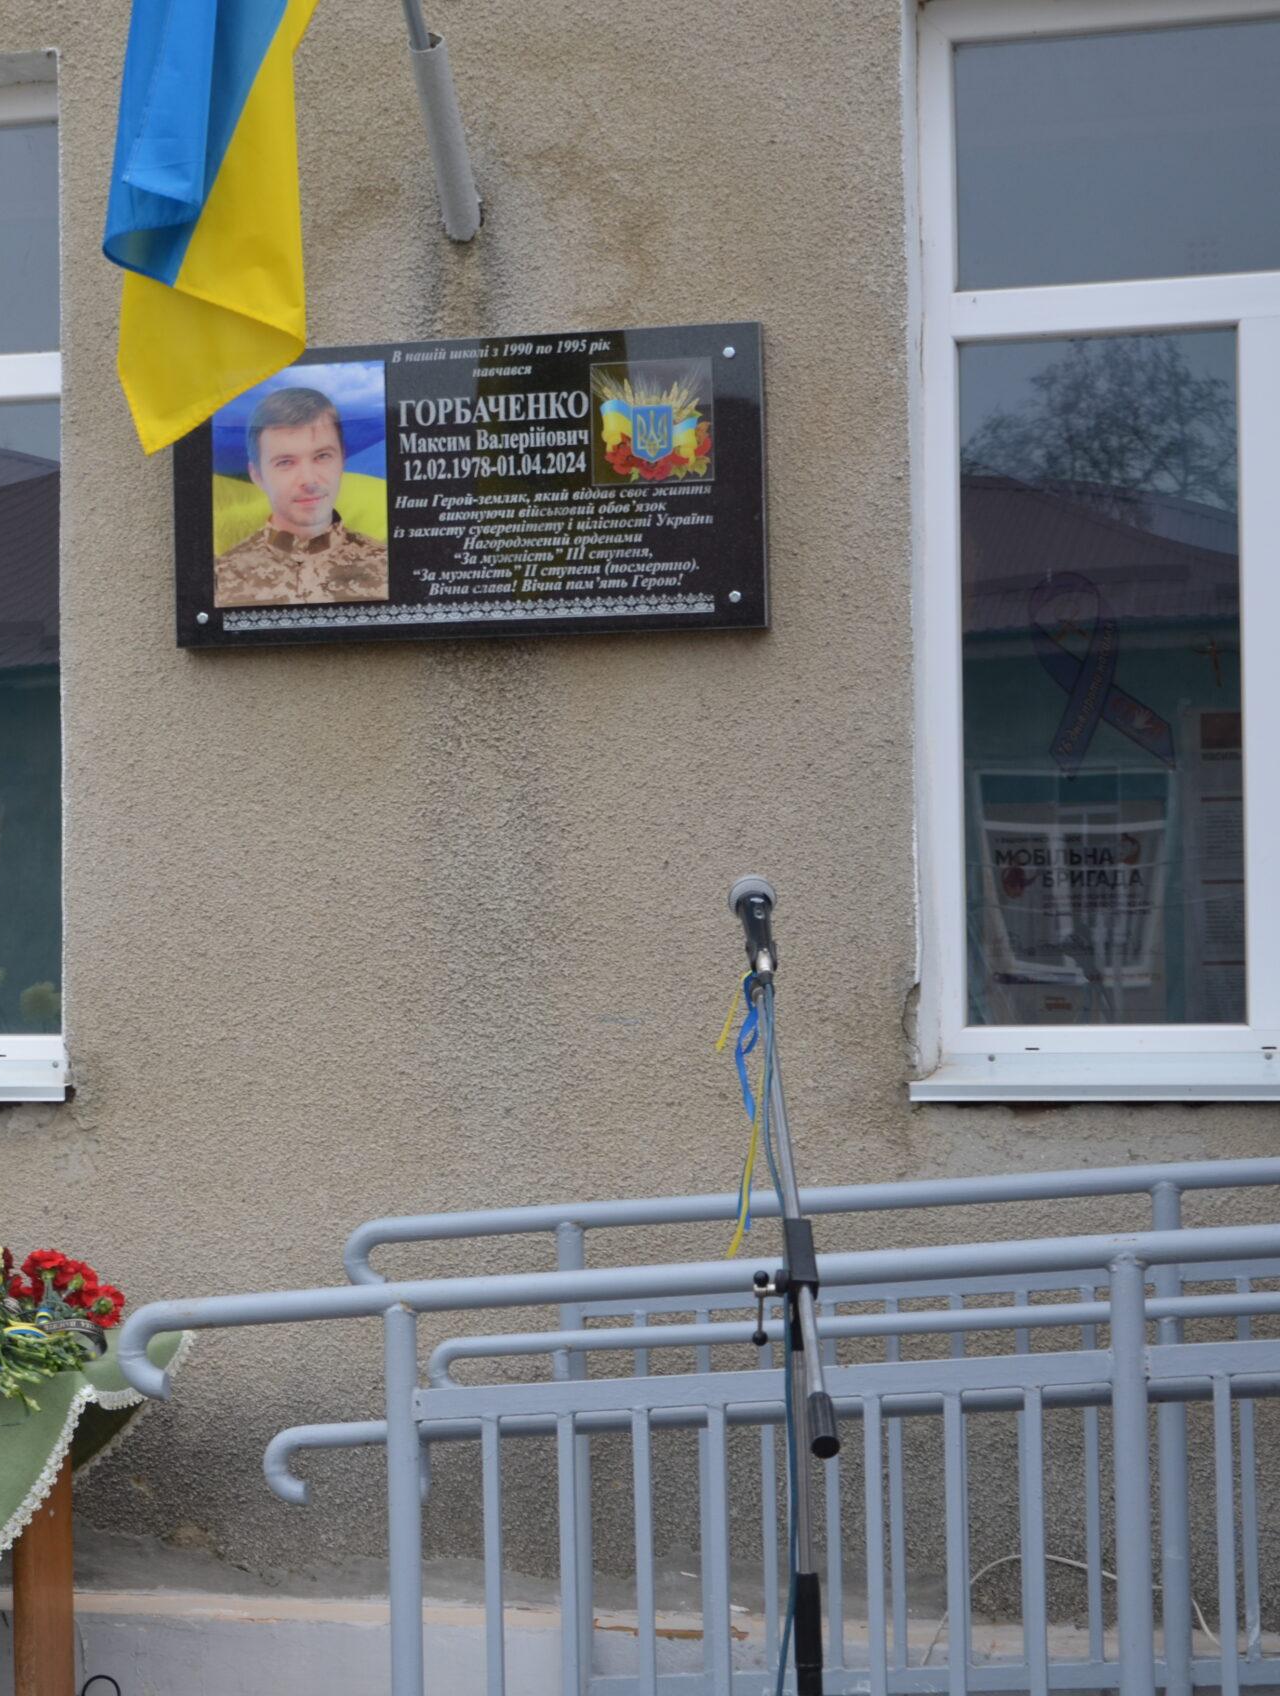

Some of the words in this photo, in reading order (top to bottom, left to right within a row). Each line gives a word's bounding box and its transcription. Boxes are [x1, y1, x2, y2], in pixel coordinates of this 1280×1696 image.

[392, 351, 401, 363] В
[405, 349, 446, 362] нашій
[449, 345, 489, 360] школі
[492, 348, 499, 358] з
[503, 342, 533, 357] 1990
[535, 344, 553, 356] по
[557, 340, 587, 354] 1995
[589, 339, 611, 355] рік
[472, 365, 532, 378] навчався
[398, 390, 589, 427] ГОРБАЧЕНКО
[400, 432, 470, 454] Максим
[476, 426, 589, 454] Валерійович
[404, 451, 586, 481] 12.02.1978-01.04.2024
[395, 496, 427, 509] Наш
[432, 493, 530, 509] Герой-земляк,
[534, 489, 569, 503] який
[572, 489, 616, 501] віддав
[652, 484, 712, 496] життя
[438, 507, 515, 522] виконуючи
[519, 503, 595, 517] військовий
[393, 526, 404, 538] із
[408, 524, 466, 538] захисту
[468, 520, 565, 537] суверенітету
[567, 520, 573, 531] і
[576, 515, 652, 533] цілісності
[656, 513, 714, 529] України
[463, 534, 571, 551] Нагороджений
[573, 532, 643, 547] орденами
[589, 548, 653, 562] ступеня,
[540, 564, 601, 578] ступеня
[604, 558, 700, 575] (посмертно).
[429, 583, 469, 596] Вічна
[472, 582, 517, 595] слава!
[521, 579, 562, 592] Вічна
[632, 574, 684, 590] Герою!
[995, 848, 1114, 866] МОБІЛЬНА
[1042, 868, 1144, 889] БРИГАДА
